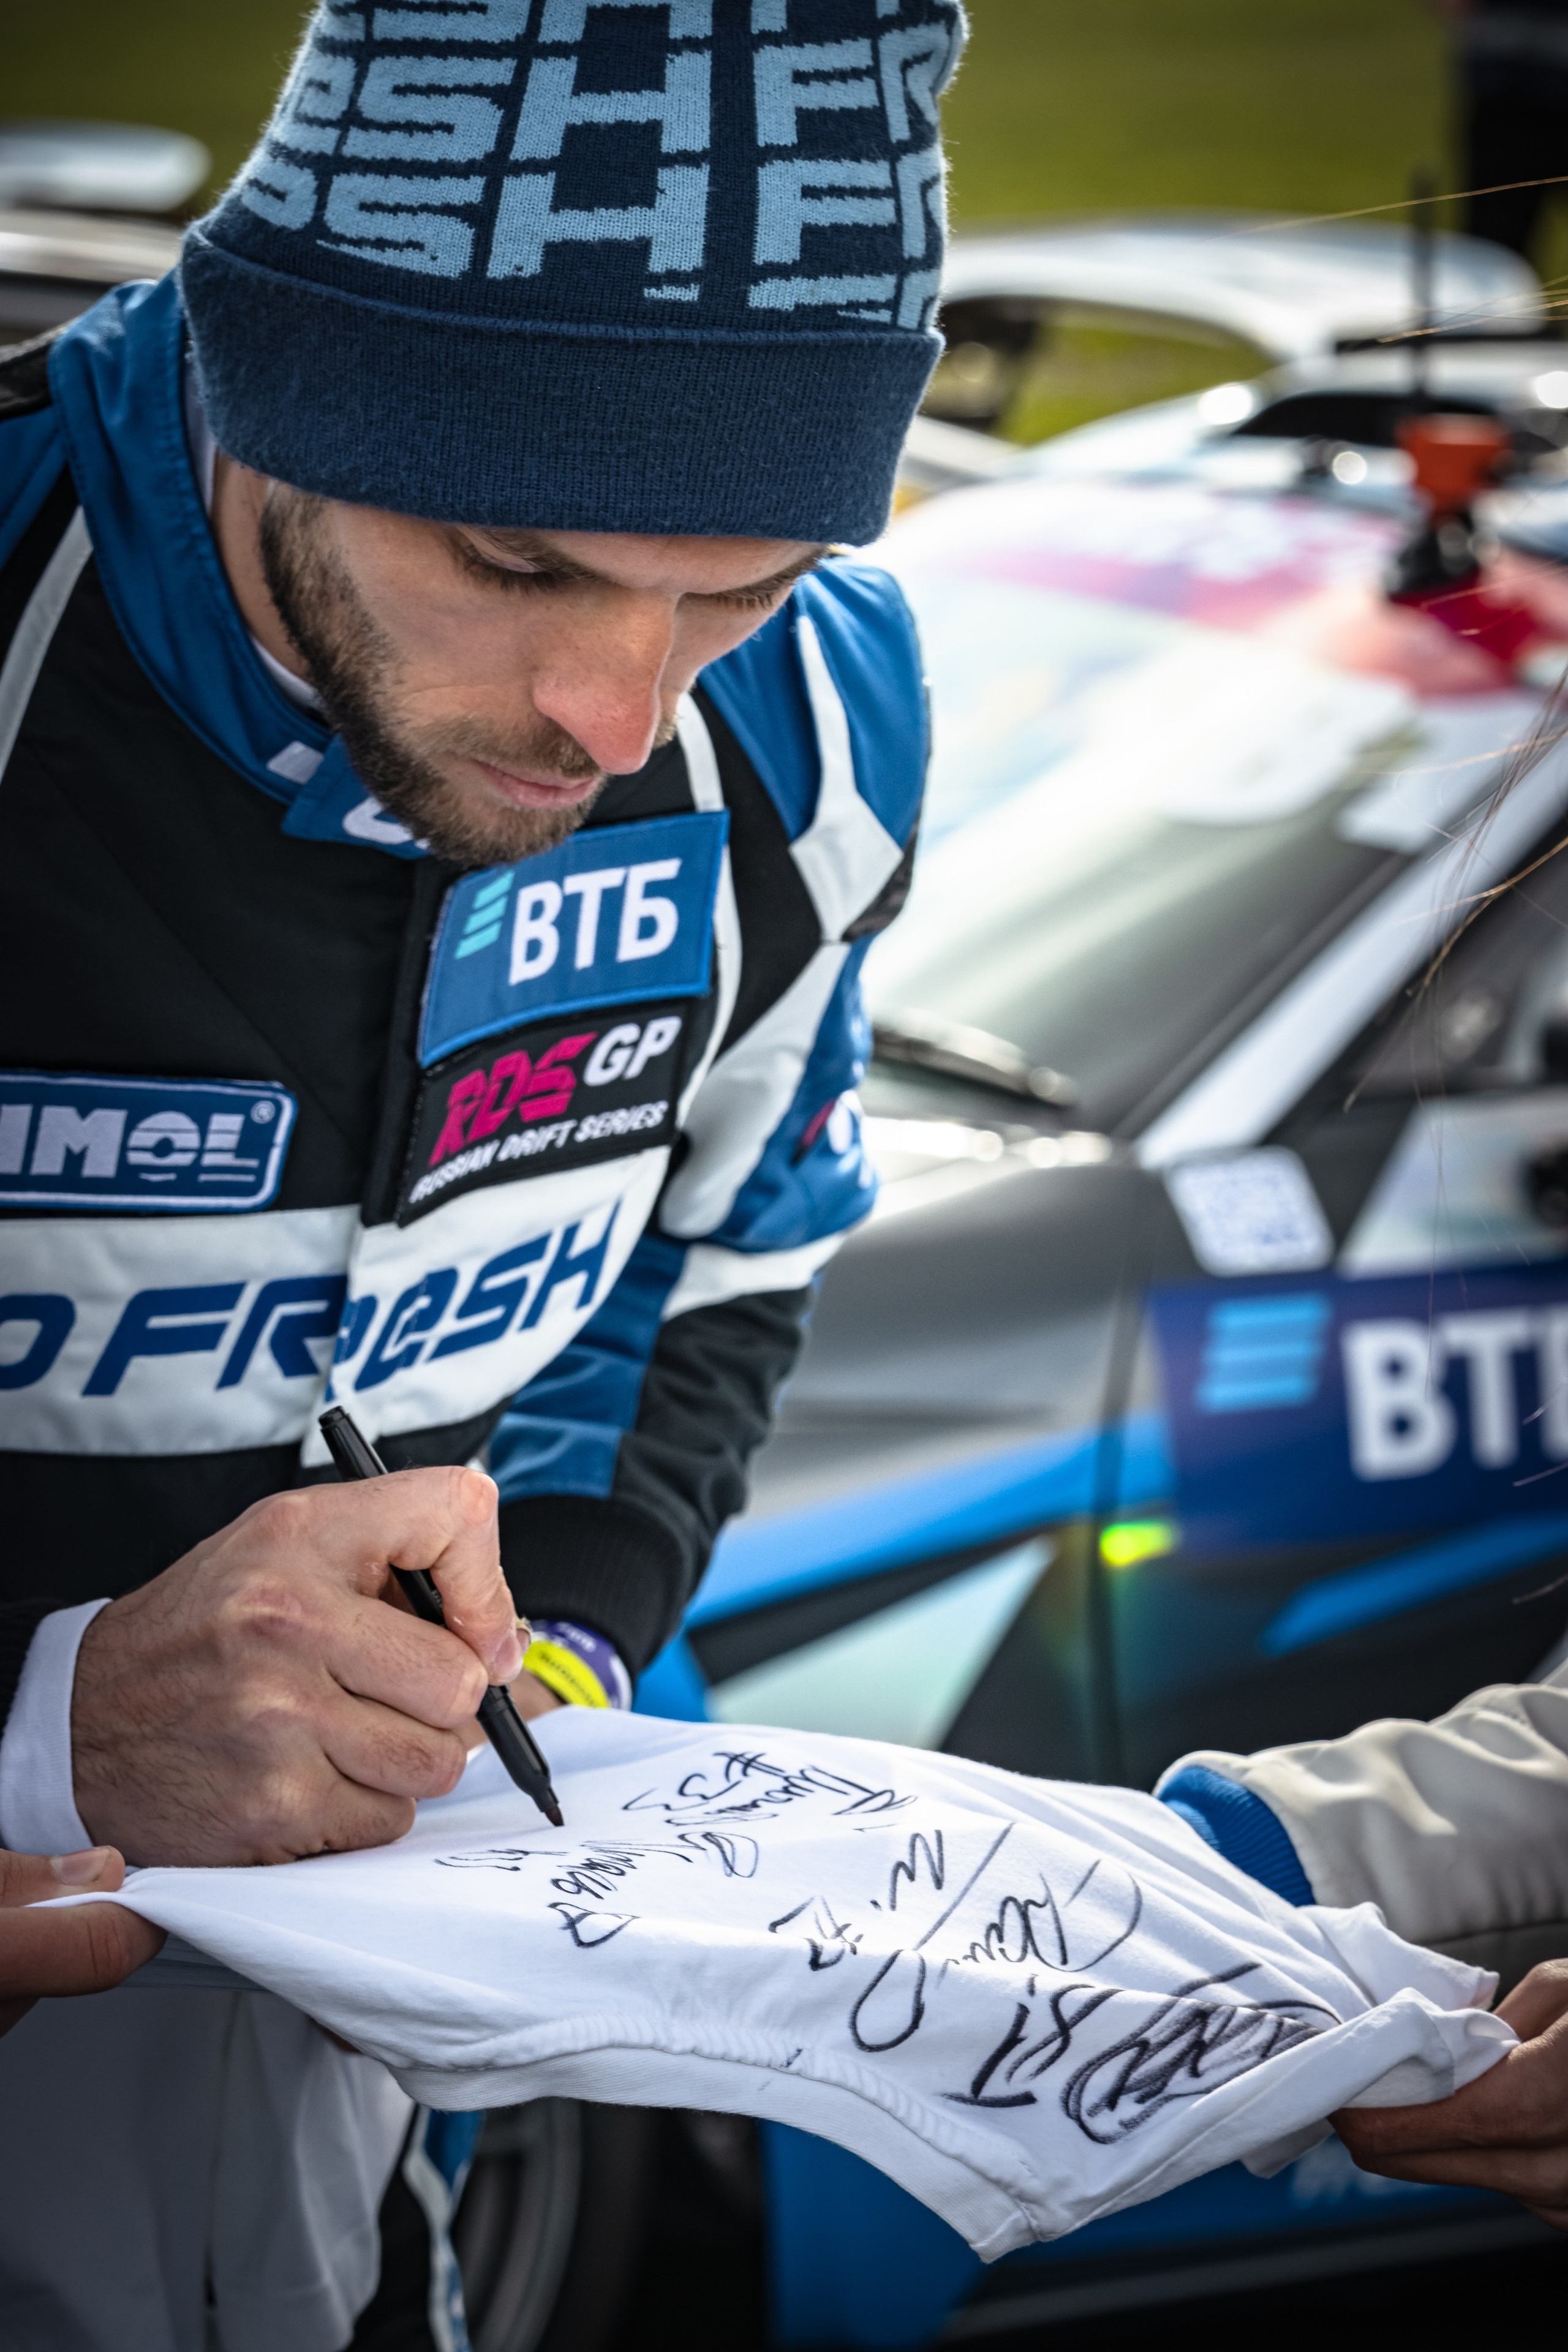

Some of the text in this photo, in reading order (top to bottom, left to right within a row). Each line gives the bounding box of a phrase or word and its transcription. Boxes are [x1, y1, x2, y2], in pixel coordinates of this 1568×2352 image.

[508, 858, 682, 986] ВТБ
[409, 1099, 669, 1204] RUSSIAN DRIFT SERIES
[428, 1015, 682, 1167] RDS GP
